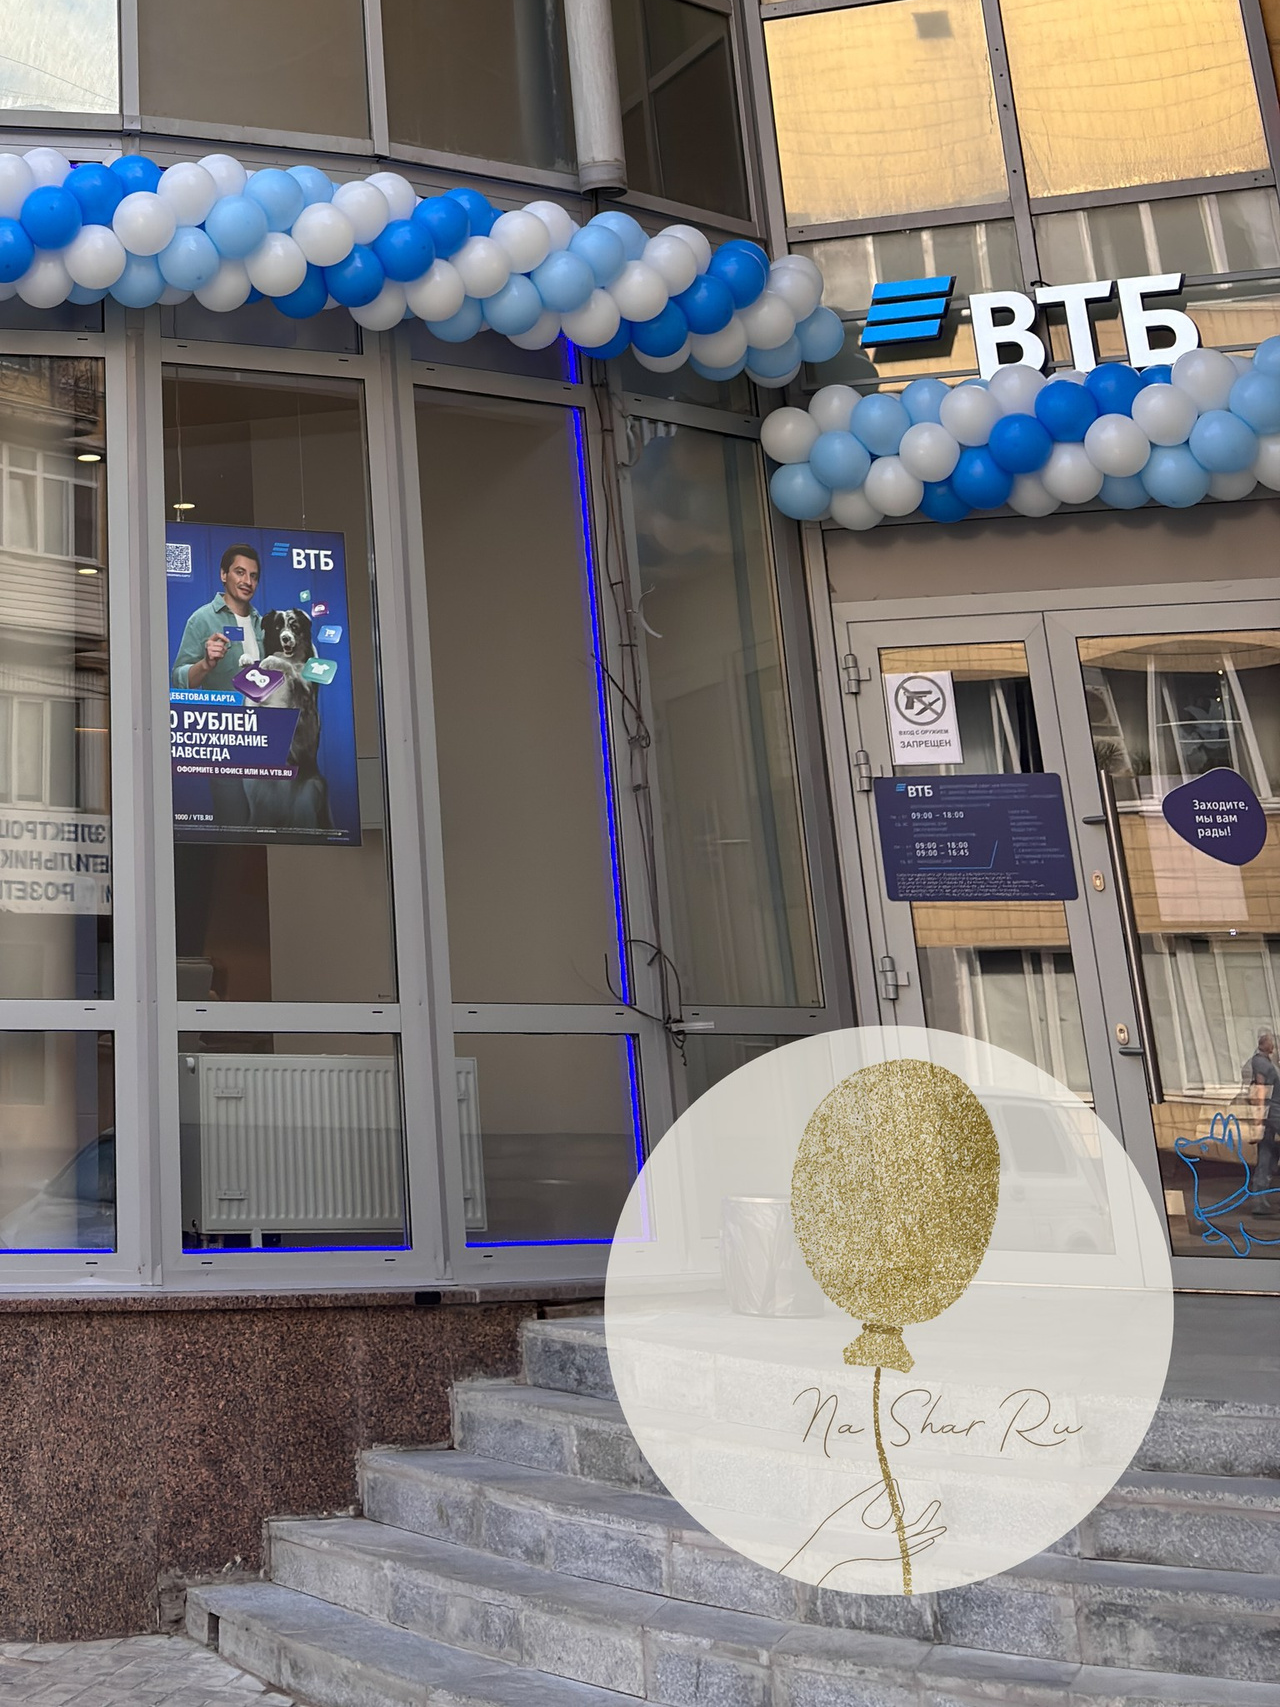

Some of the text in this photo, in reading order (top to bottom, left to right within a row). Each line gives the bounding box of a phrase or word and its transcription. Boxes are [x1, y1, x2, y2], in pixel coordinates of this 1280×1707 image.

[968, 272, 1201, 380] ВТБ
[292, 548, 334, 571] ВТБ
[210, 694, 236, 703] КАРТА
[183, 709, 258, 732] РУБЛЕЙ
[170, 731, 269, 747] ОБСЛУЖИВАНИЕ
[900, 739, 952, 749] ЗАПРЕЩЕН
[170, 746, 231, 761] НАВСЕГДА
[176, 765, 213, 774] ОФОРМИТЕ
[220, 767, 243, 775] ОФИСЕ
[259, 768, 269, 776] НА
[269, 769, 293, 777] VTB.RU
[907, 784, 934, 798] ВТБ
[1192, 799, 1249, 811] Заходите,
[174, 813, 188, 821] 1000
[910, 811, 933, 820] 09:00
[943, 811, 965, 819] 18:00
[1195, 814, 1238, 823] мы вам
[1197, 826, 1231, 839] рады!
[915, 841, 937, 849] 09:00
[946, 841, 969, 849] 18:00
[916, 849, 938, 857] 09:00
